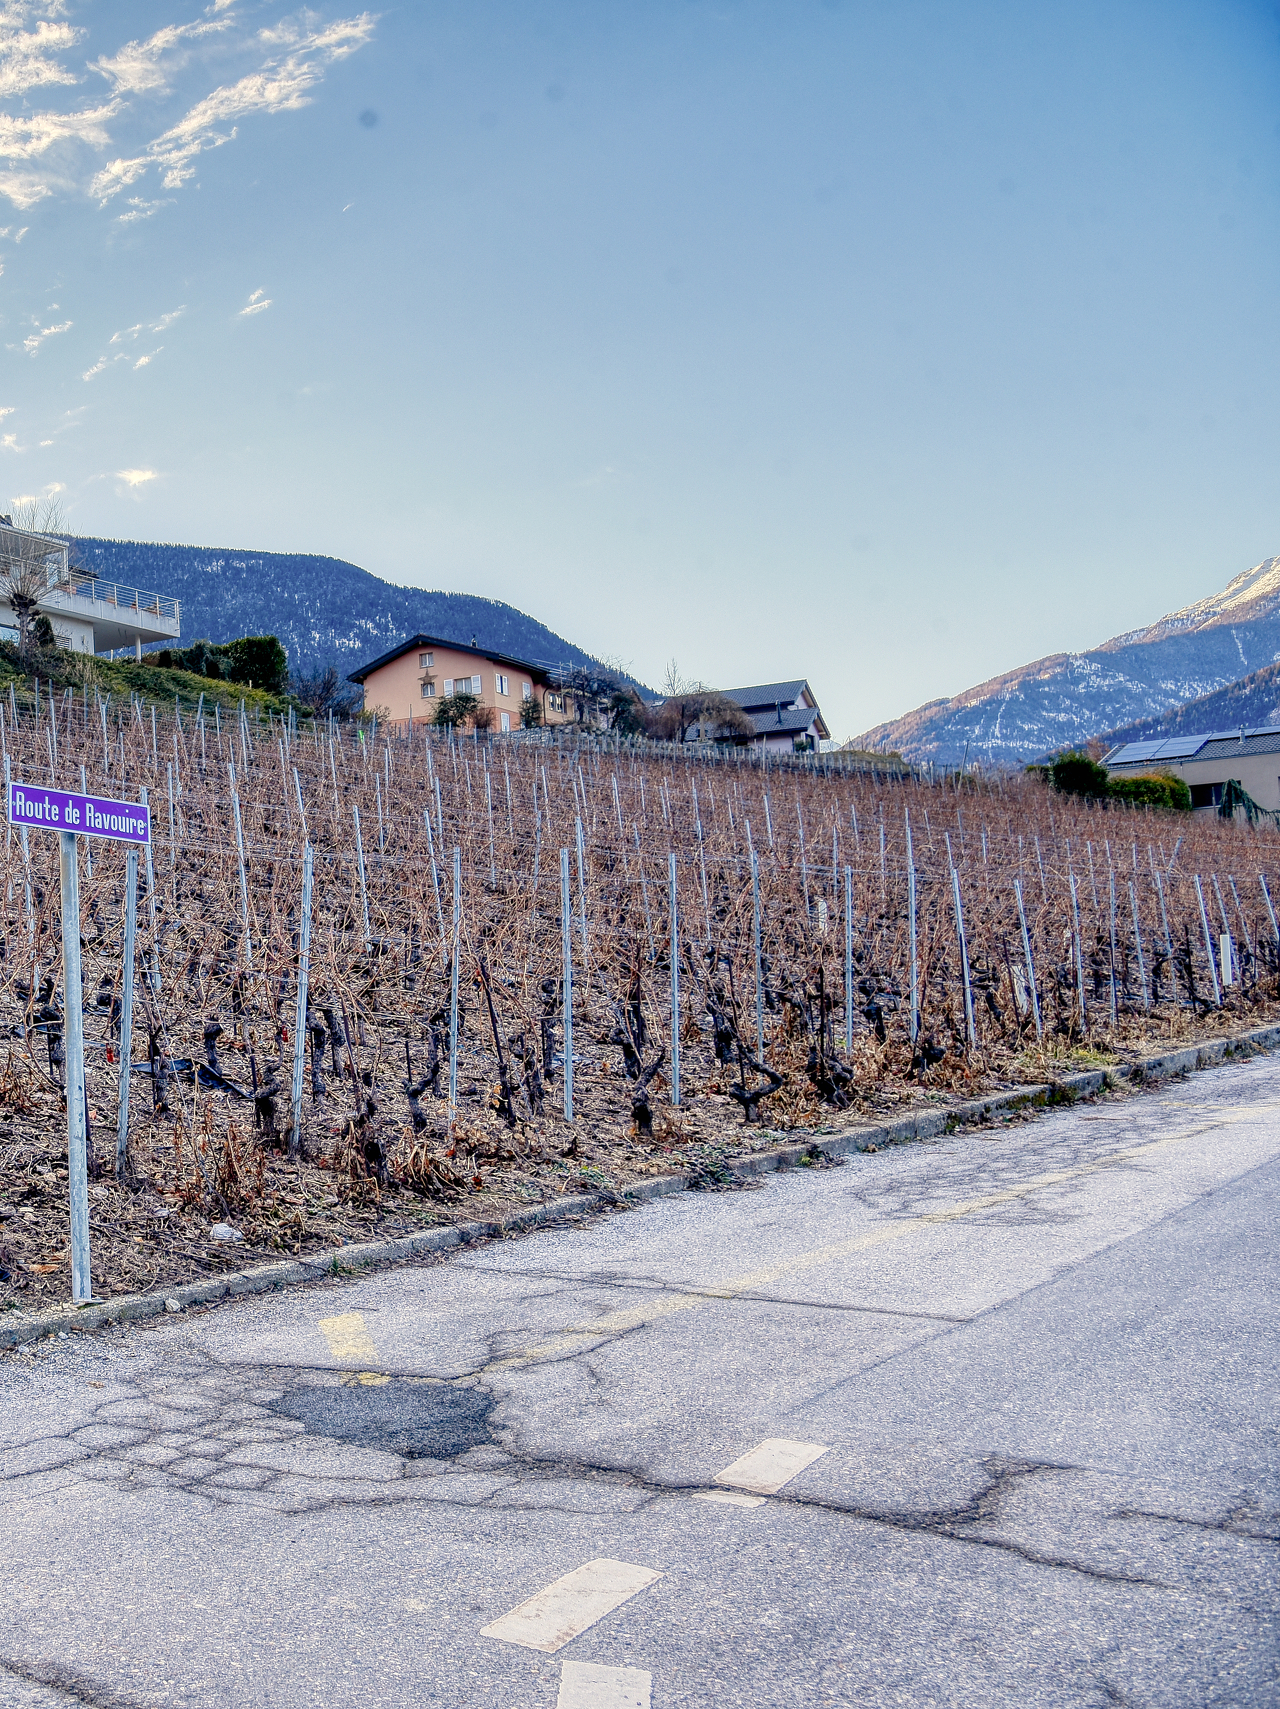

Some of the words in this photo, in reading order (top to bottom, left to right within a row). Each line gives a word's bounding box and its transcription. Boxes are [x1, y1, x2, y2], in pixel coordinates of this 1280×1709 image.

[16, 791, 59, 821] Route
[65, 800, 80, 825] de
[85, 803, 145, 835] Ravouire
